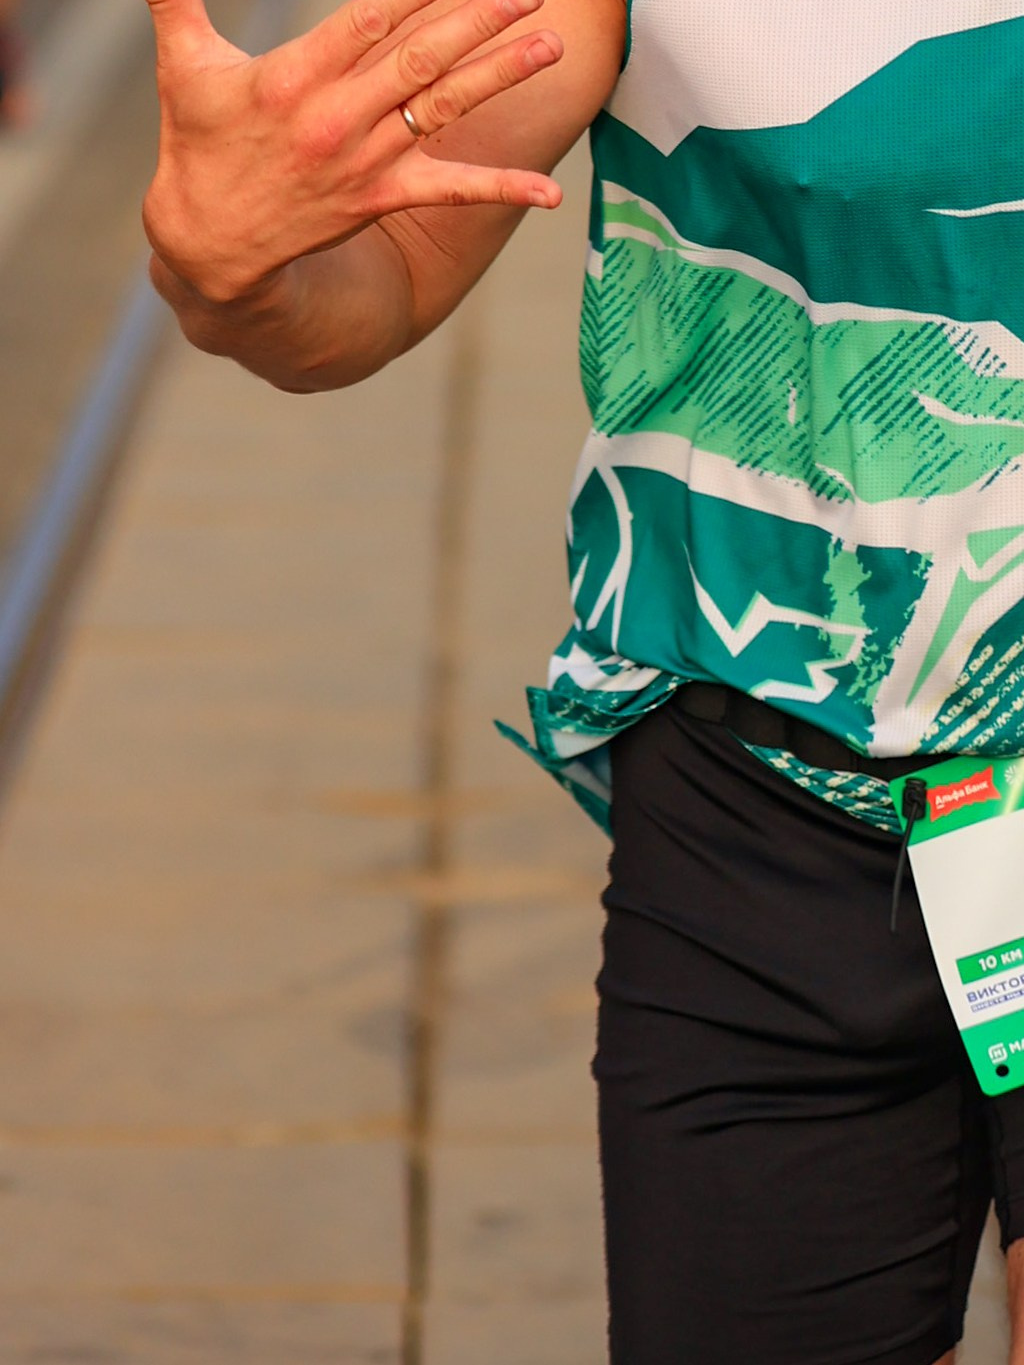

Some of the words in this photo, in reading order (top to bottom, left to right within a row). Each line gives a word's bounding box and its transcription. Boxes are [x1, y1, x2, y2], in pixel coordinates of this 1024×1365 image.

[935, 789, 966, 810] Альфа
[965, 780, 988, 797] Банк
[978, 954, 998, 972] 10
